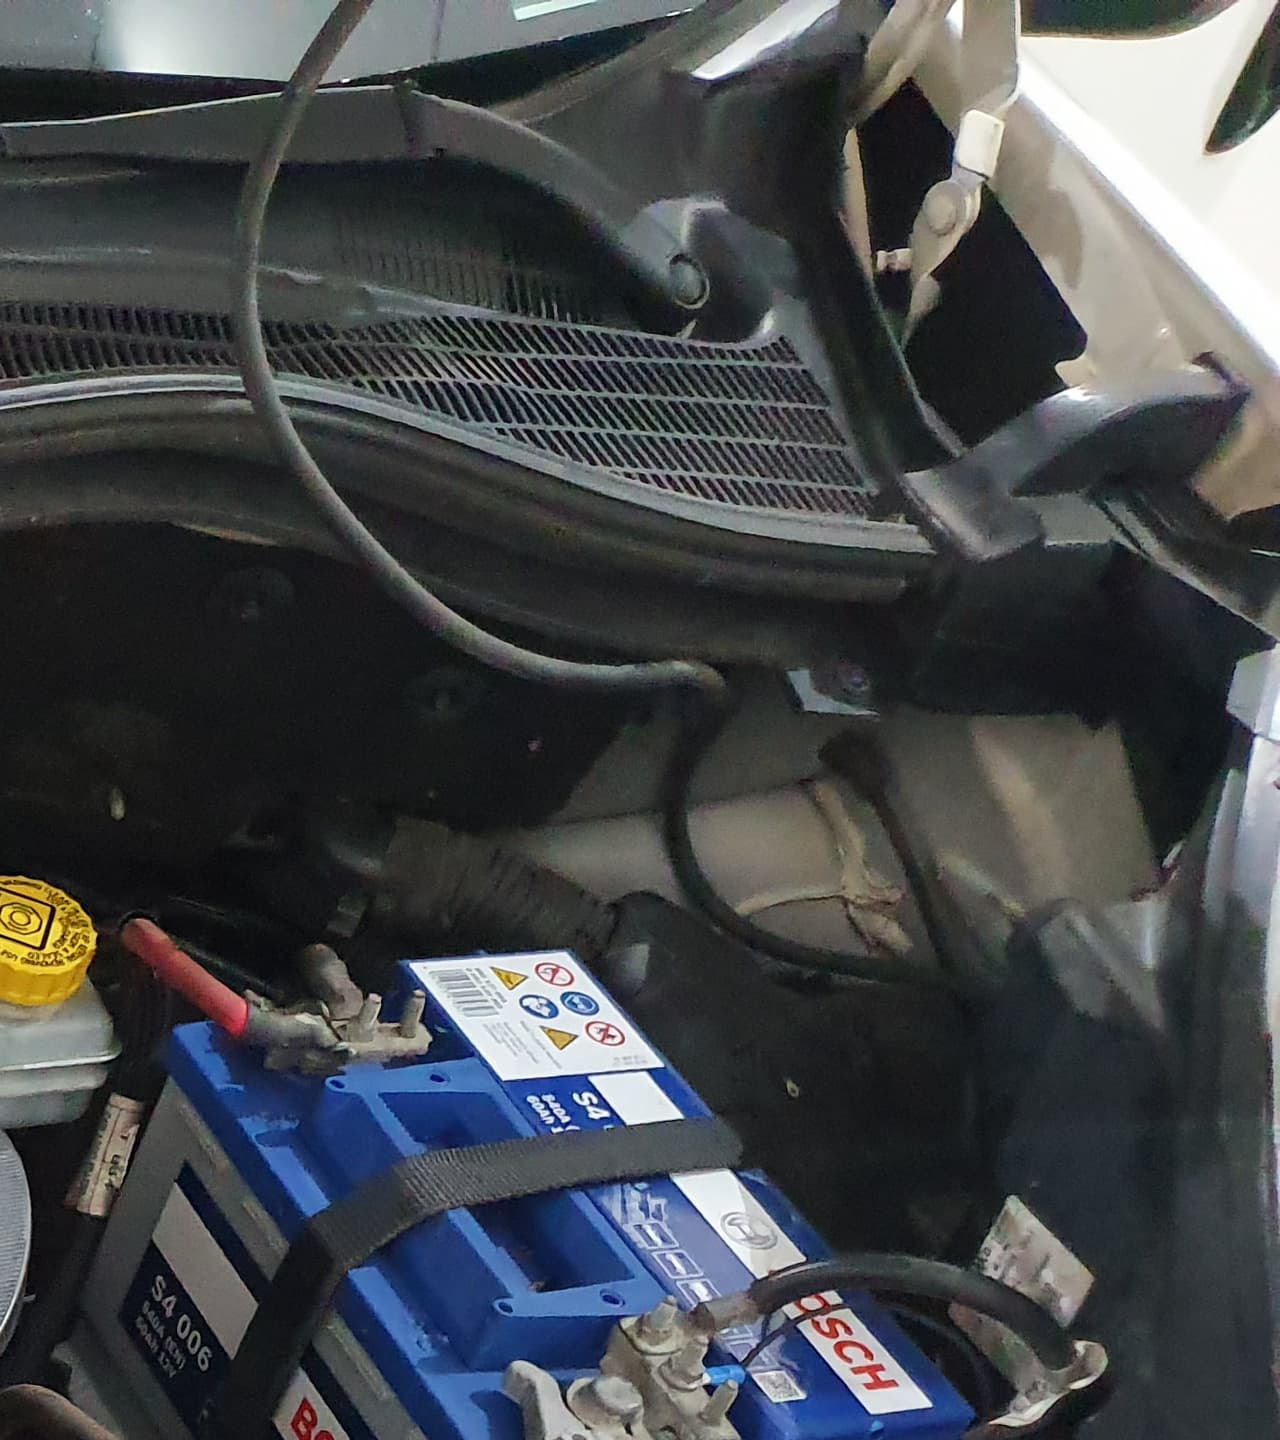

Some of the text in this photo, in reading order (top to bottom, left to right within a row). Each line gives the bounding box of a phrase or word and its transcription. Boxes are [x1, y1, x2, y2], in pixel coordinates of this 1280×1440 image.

[572, 1091, 611, 1119] S4
[151, 1275, 213, 1372] S4 006
[794, 1293, 900, 1391] OSCH
